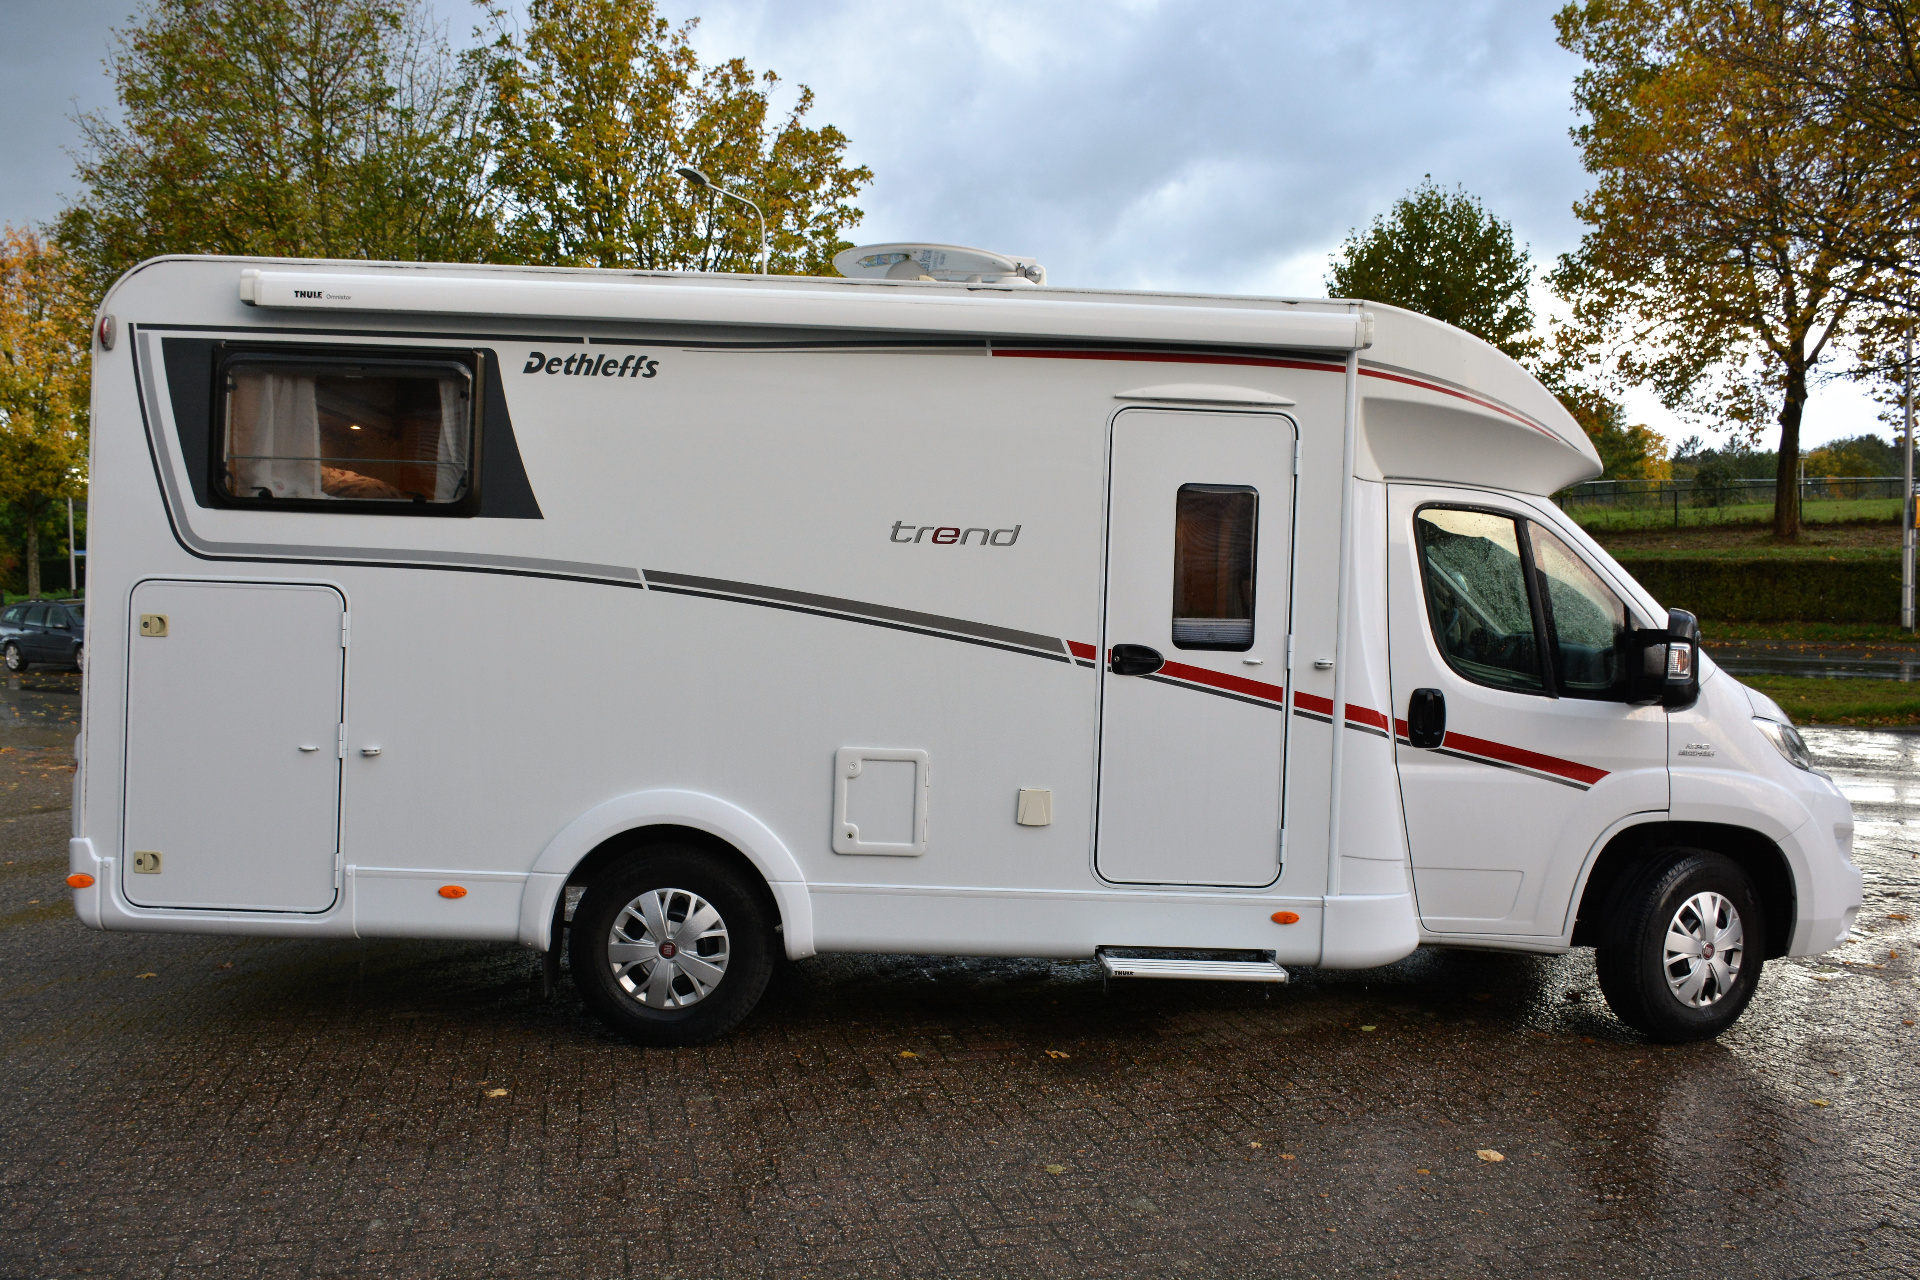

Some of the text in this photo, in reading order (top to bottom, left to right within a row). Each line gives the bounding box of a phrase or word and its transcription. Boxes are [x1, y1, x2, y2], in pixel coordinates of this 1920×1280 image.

[294, 290, 323, 299] THULE
[523, 351, 660, 378] Dethleffs
[890, 520, 1022, 546] trend
